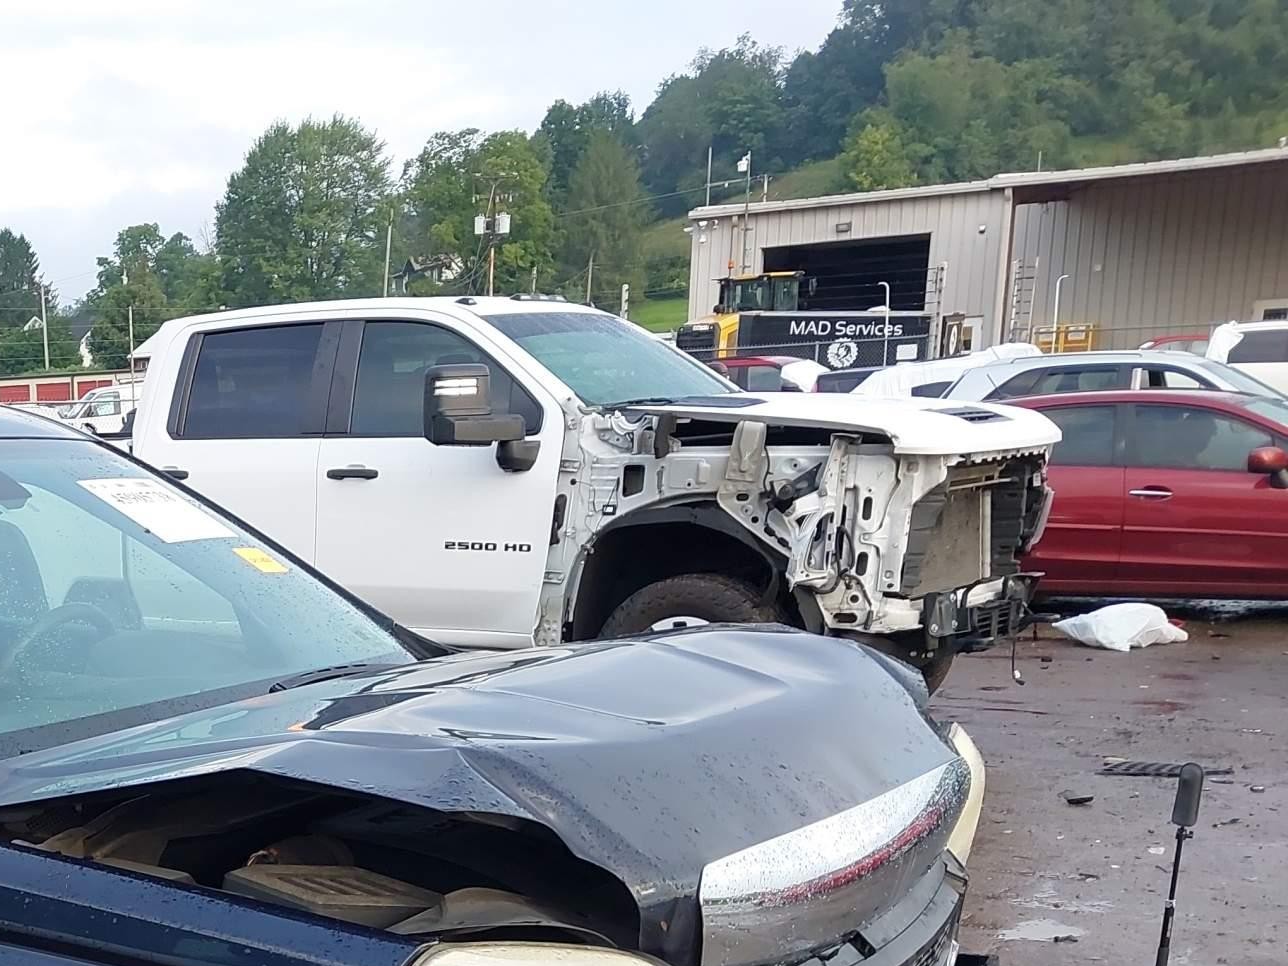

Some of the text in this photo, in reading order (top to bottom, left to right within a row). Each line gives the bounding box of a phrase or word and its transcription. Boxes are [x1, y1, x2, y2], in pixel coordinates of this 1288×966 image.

[789, 320, 904, 336] MAD Services
[444, 541, 532, 553] 2500 HD
